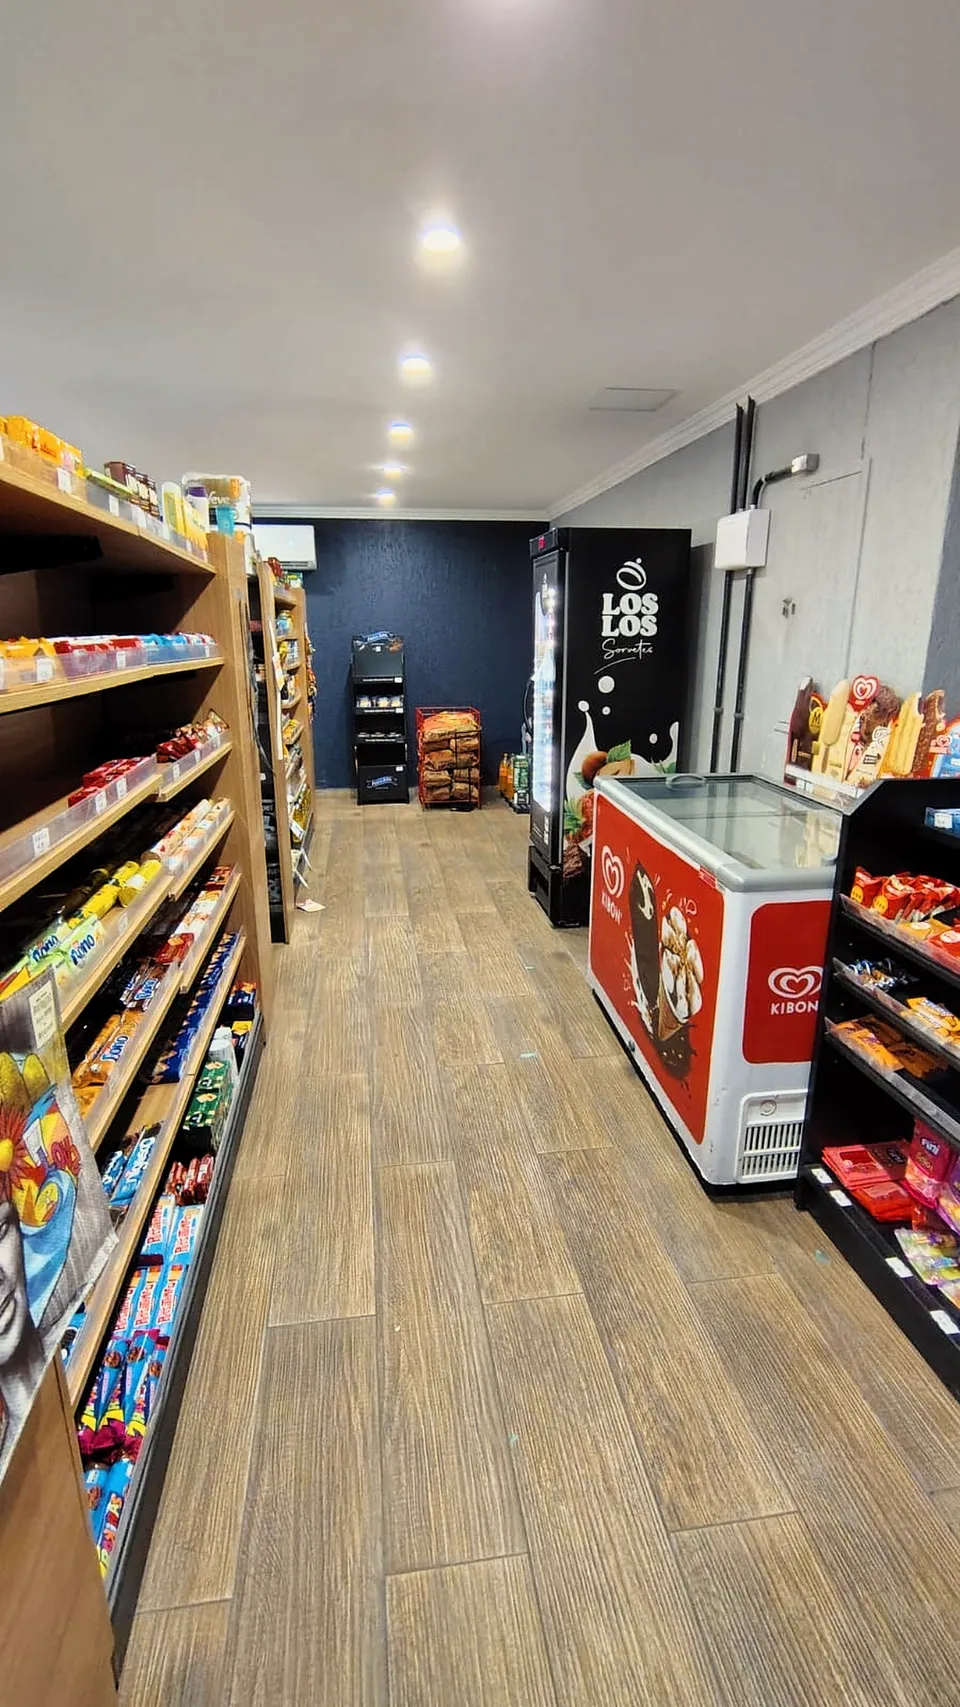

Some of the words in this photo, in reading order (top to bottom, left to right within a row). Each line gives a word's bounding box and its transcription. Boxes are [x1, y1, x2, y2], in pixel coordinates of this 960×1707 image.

[602, 592, 659, 615] LOS
[601, 615, 658, 637] LOS
[602, 638, 655, 661] Sorvetes
[601, 890, 623, 926] KIBON
[770, 1000, 820, 1015] KIBON
